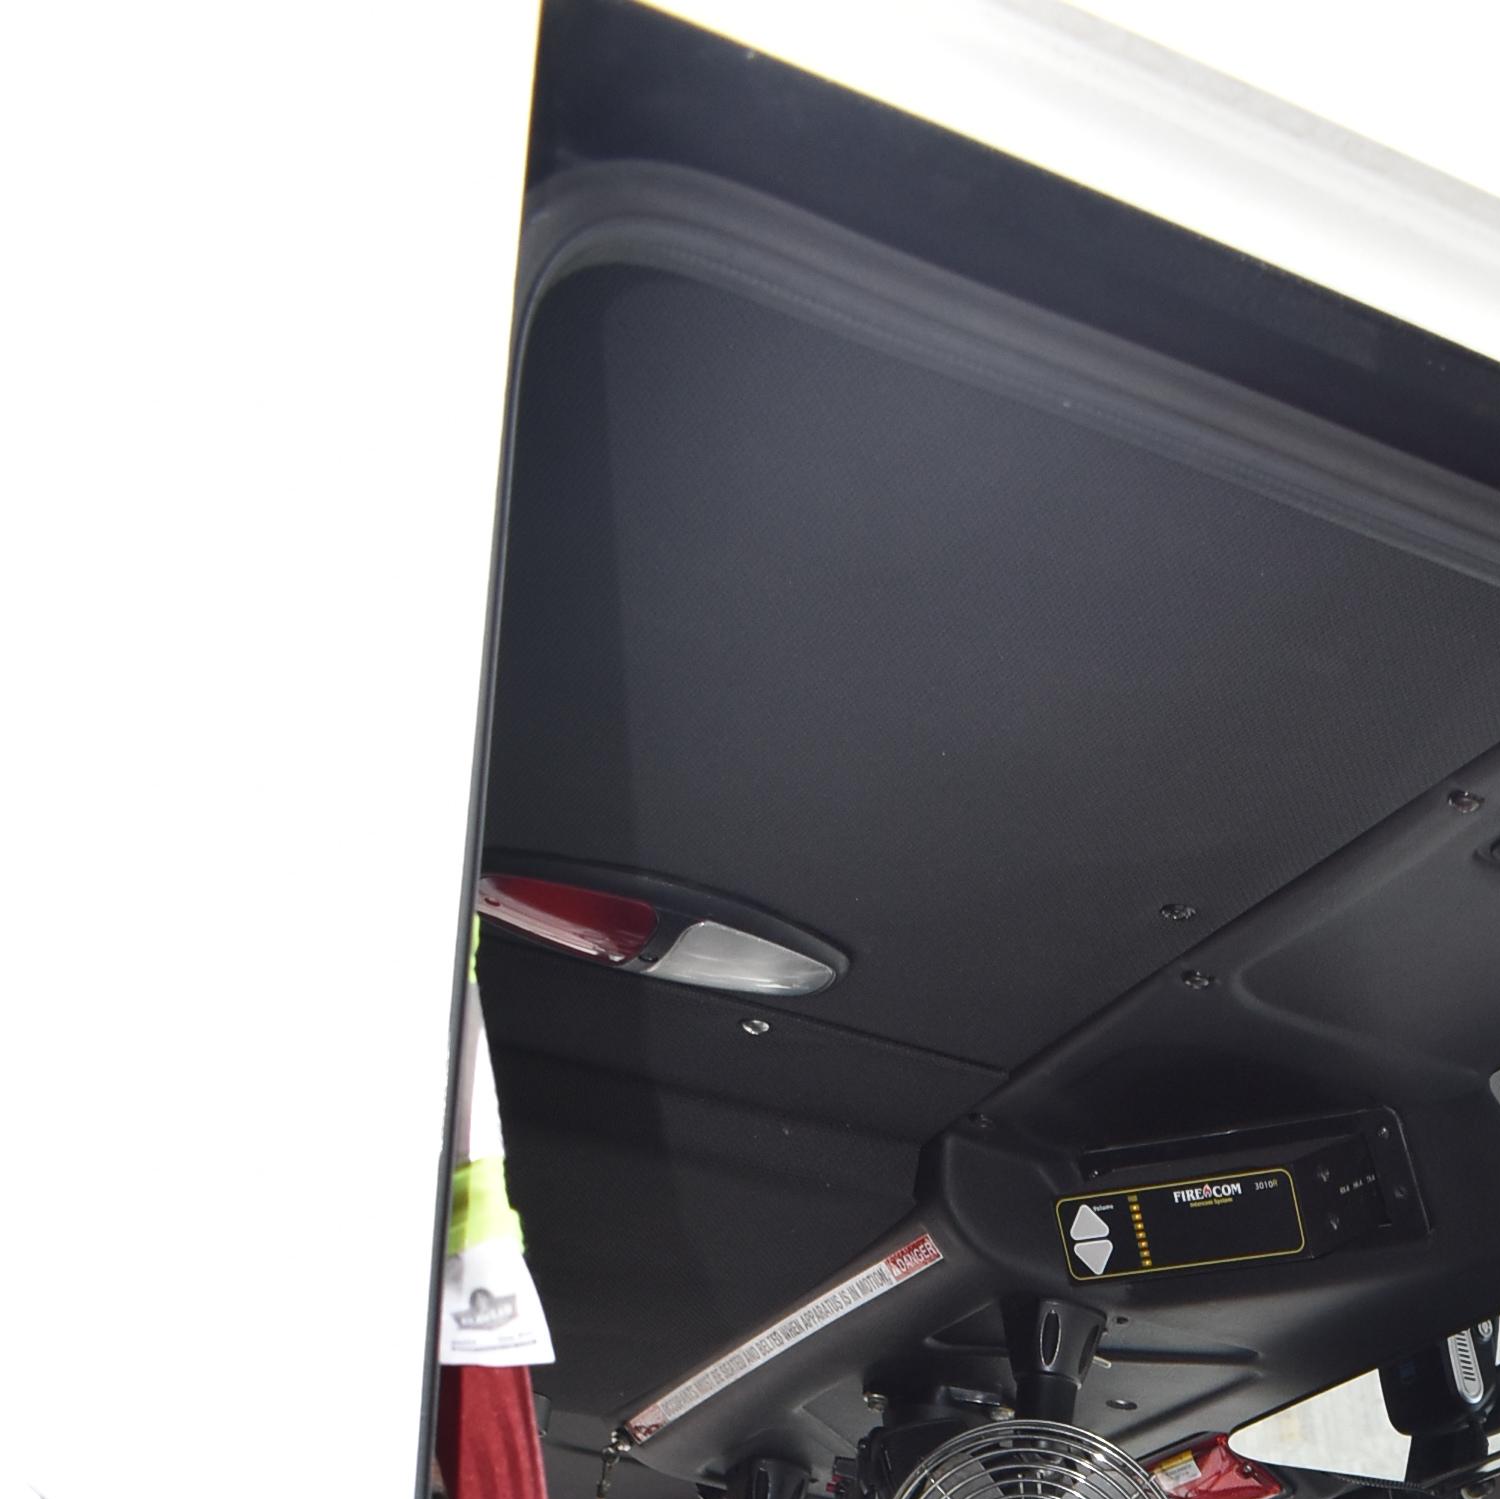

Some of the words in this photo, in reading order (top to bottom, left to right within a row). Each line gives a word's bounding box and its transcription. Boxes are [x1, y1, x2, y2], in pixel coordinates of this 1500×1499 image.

[896, 1241, 938, 1273] DANGER
[755, 1331, 784, 1356] BELTED
[800, 1295, 843, 1331] APPARATUS
[839, 1290, 852, 1305] IS
[848, 1284, 860, 1300] IN
